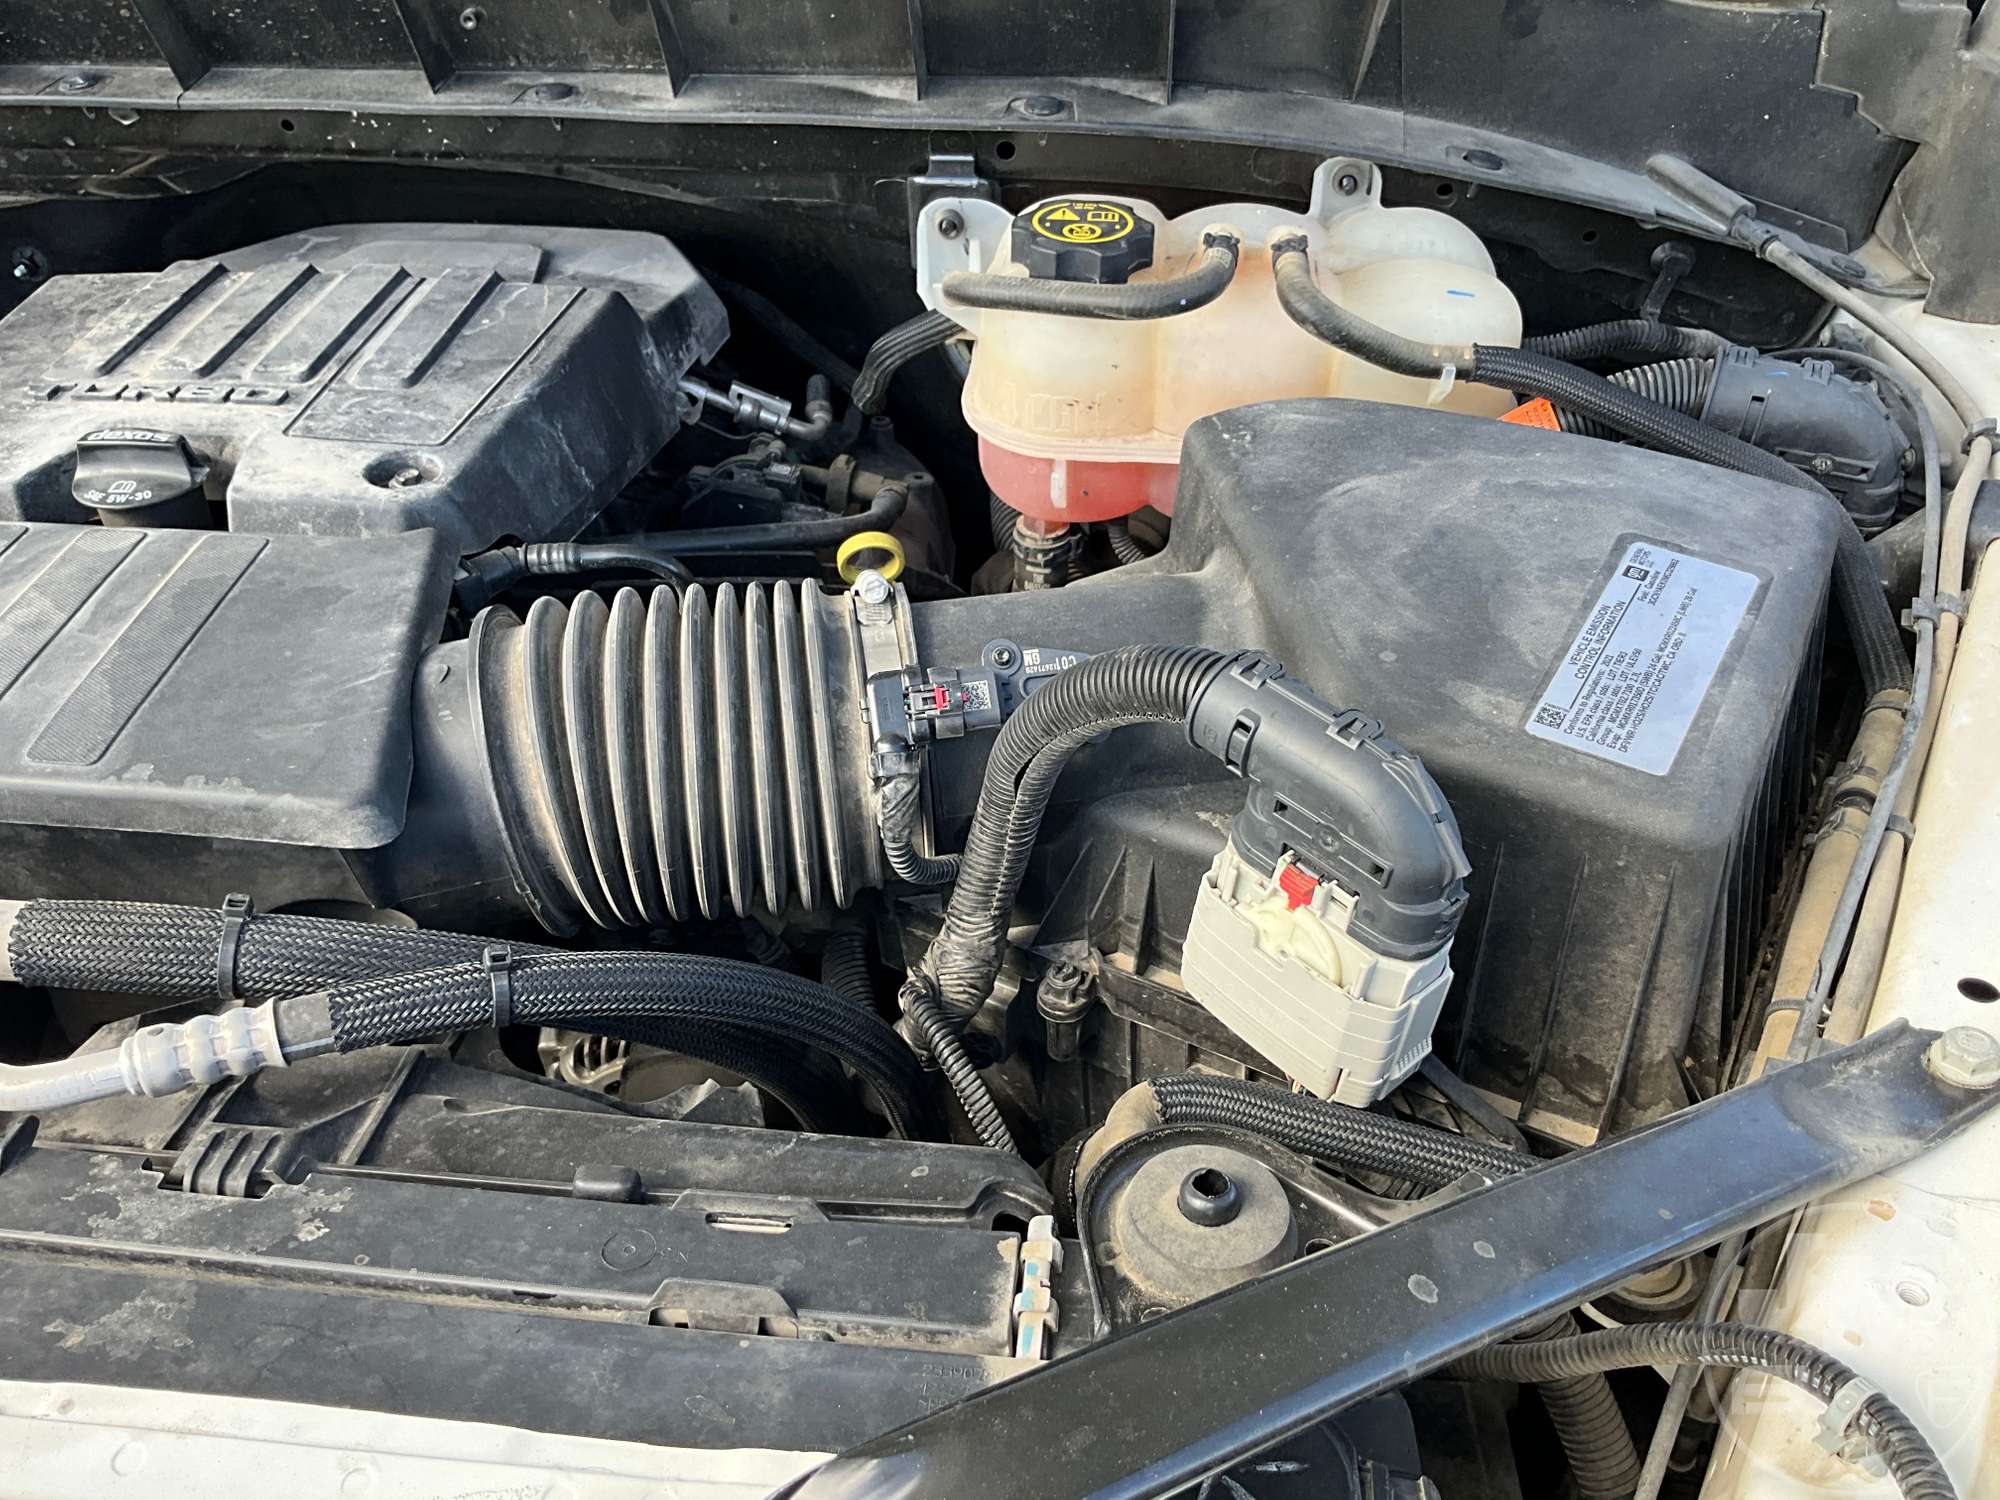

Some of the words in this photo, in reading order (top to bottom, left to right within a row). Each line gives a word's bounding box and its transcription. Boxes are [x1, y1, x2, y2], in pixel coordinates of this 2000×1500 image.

[87, 429, 172, 443] dexos
[83, 491, 104, 503] SAE
[106, 490, 153, 504] 5W-30
[1024, 650, 1041, 667] GM
[1568, 636, 1592, 665] VEHICLE
[1585, 604, 1610, 636] EMISSION
[1574, 645, 1600, 679] CONTROL
[1594, 600, 1625, 644] INFORMATION
[1564, 708, 1584, 734] Conforms
[1582, 669, 1607, 701] Regulations:
[1581, 713, 1594, 725] EPA
[1606, 669, 1618, 680] LDT
[1585, 715, 1606, 741] California
[1618, 670, 1630, 681] LDT
